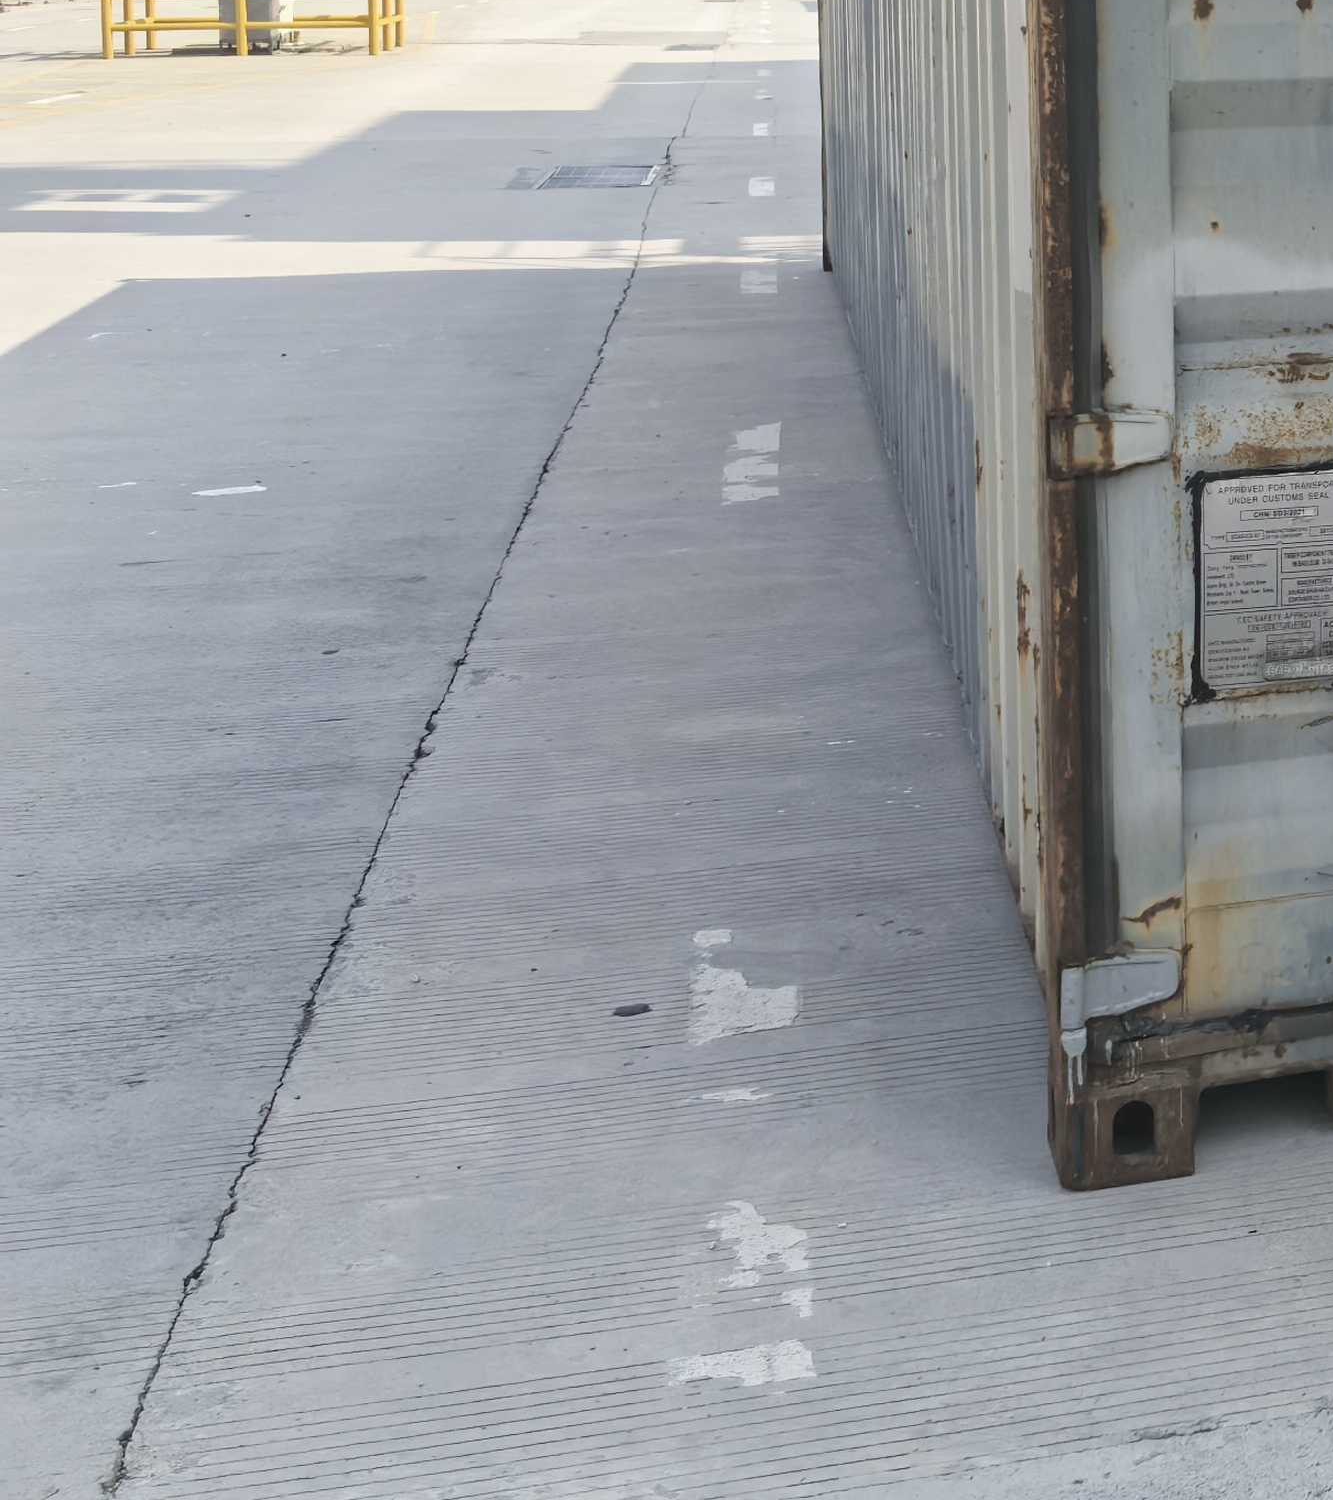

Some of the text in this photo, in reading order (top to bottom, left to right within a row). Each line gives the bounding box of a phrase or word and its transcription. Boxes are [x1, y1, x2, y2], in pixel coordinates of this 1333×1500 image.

[1218, 484, 1264, 494] APPROVED
[1228, 492, 1329, 505] UNDER CUSTOMS SEAL
